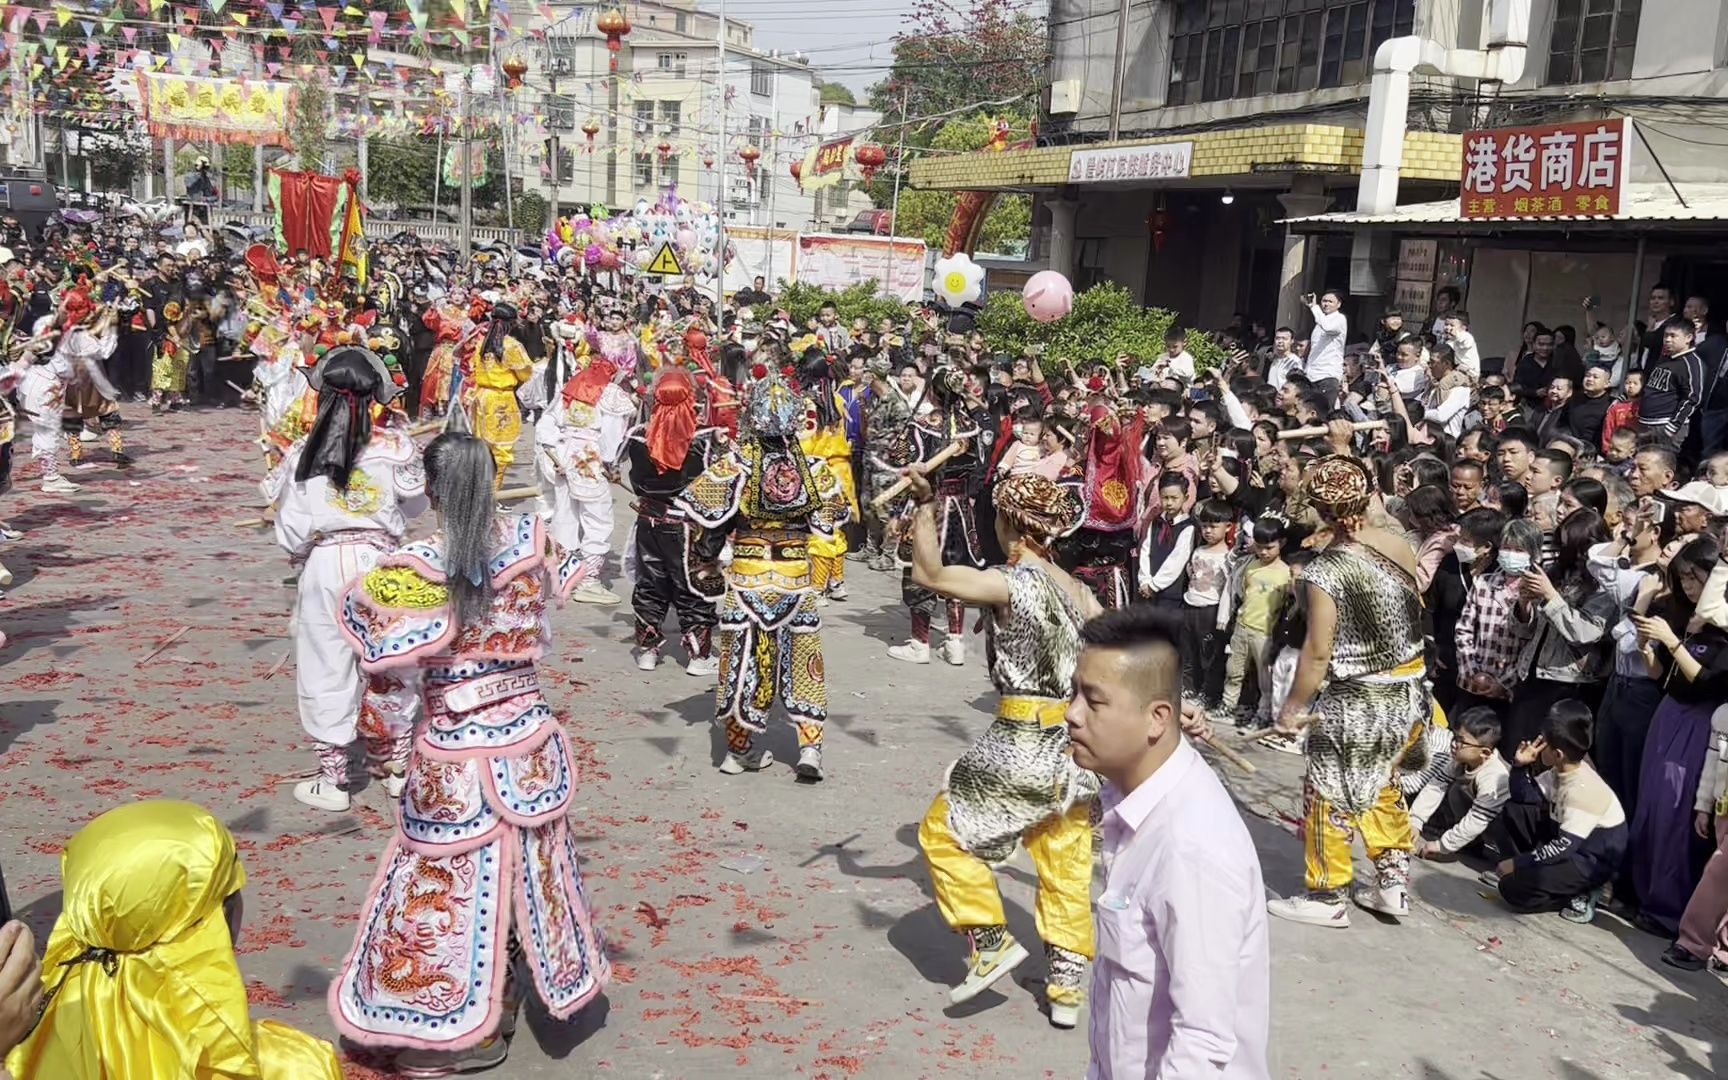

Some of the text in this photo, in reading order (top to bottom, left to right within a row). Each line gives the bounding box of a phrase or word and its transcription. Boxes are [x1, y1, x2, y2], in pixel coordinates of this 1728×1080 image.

[1464, 126, 1619, 193] 港货商店
[1514, 196, 1562, 212] 烟茶酒
[1576, 194, 1610, 211] 零食
